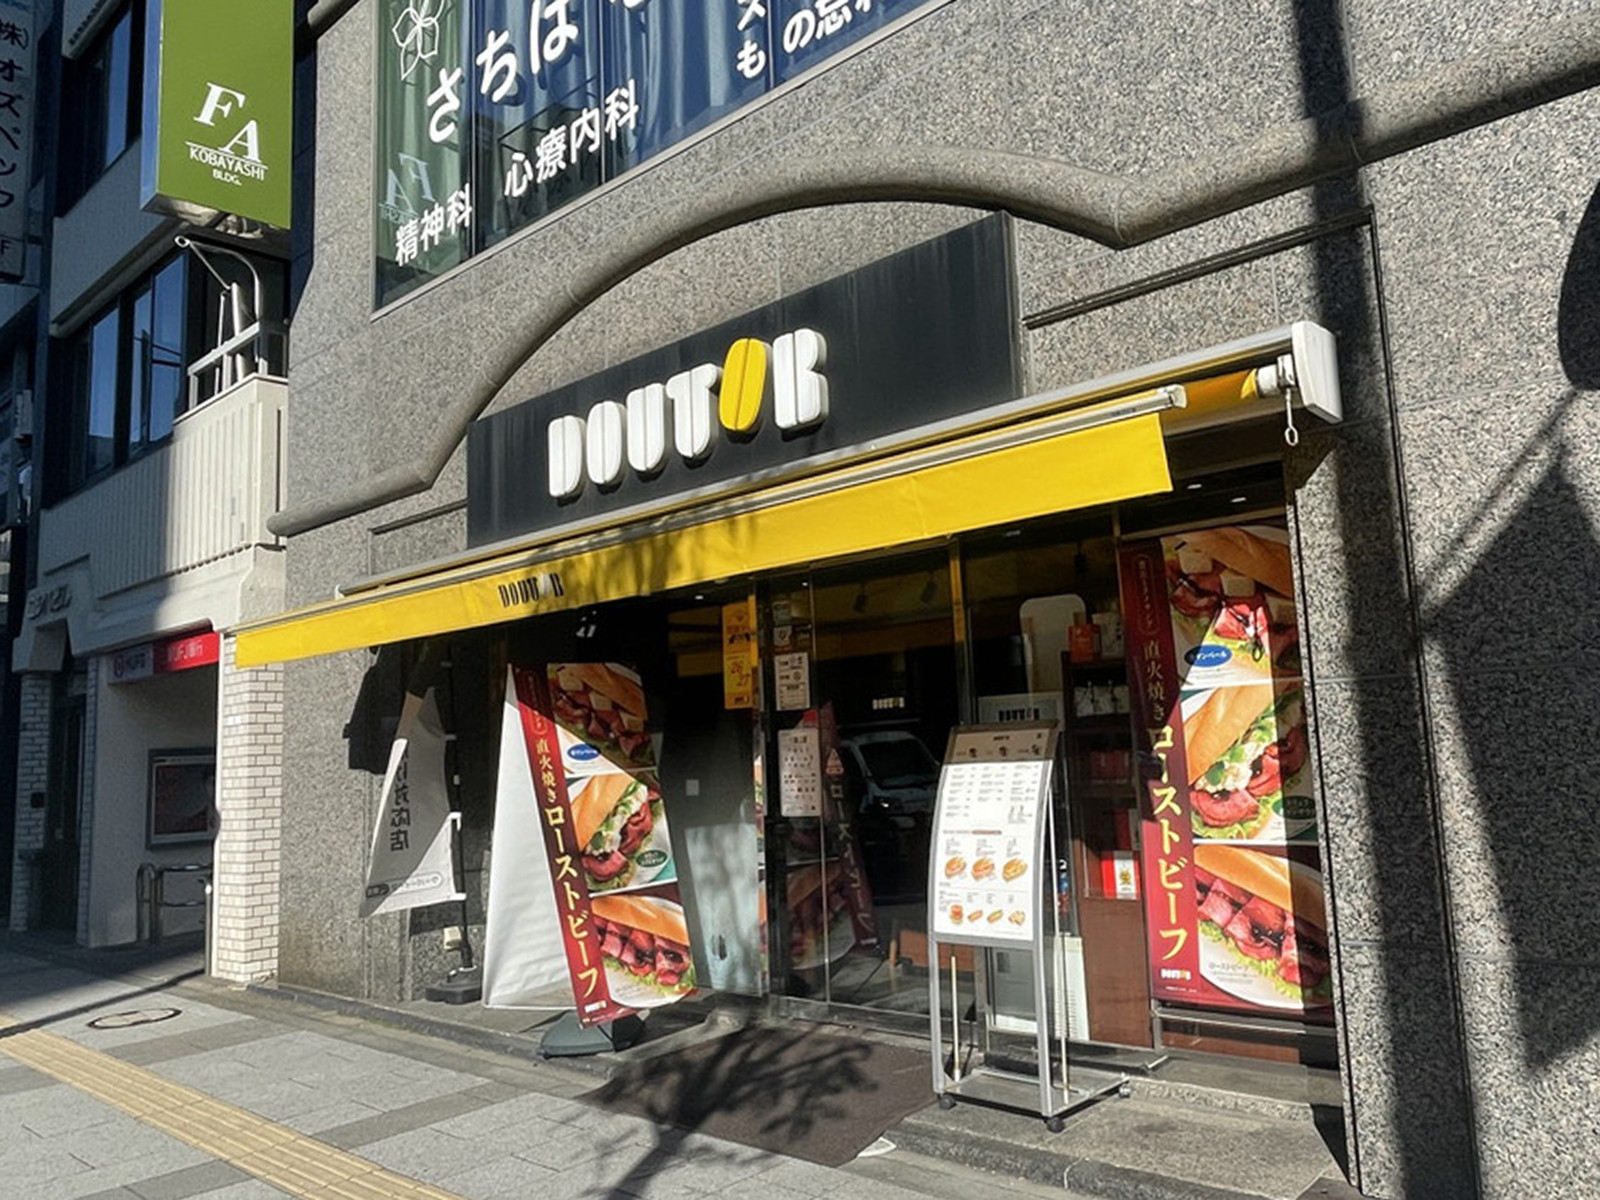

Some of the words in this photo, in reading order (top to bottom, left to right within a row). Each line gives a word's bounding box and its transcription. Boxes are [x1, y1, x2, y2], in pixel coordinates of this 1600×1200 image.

[427, 0, 645, 143] さちは
[736, 0, 872, 79] もの忘
[189, 146, 265, 181] KOBAYASHI
[395, 182, 472, 267] 精神科
[504, 78, 639, 198] 心療内科
[548, 328, 829, 499] DOUTOR
